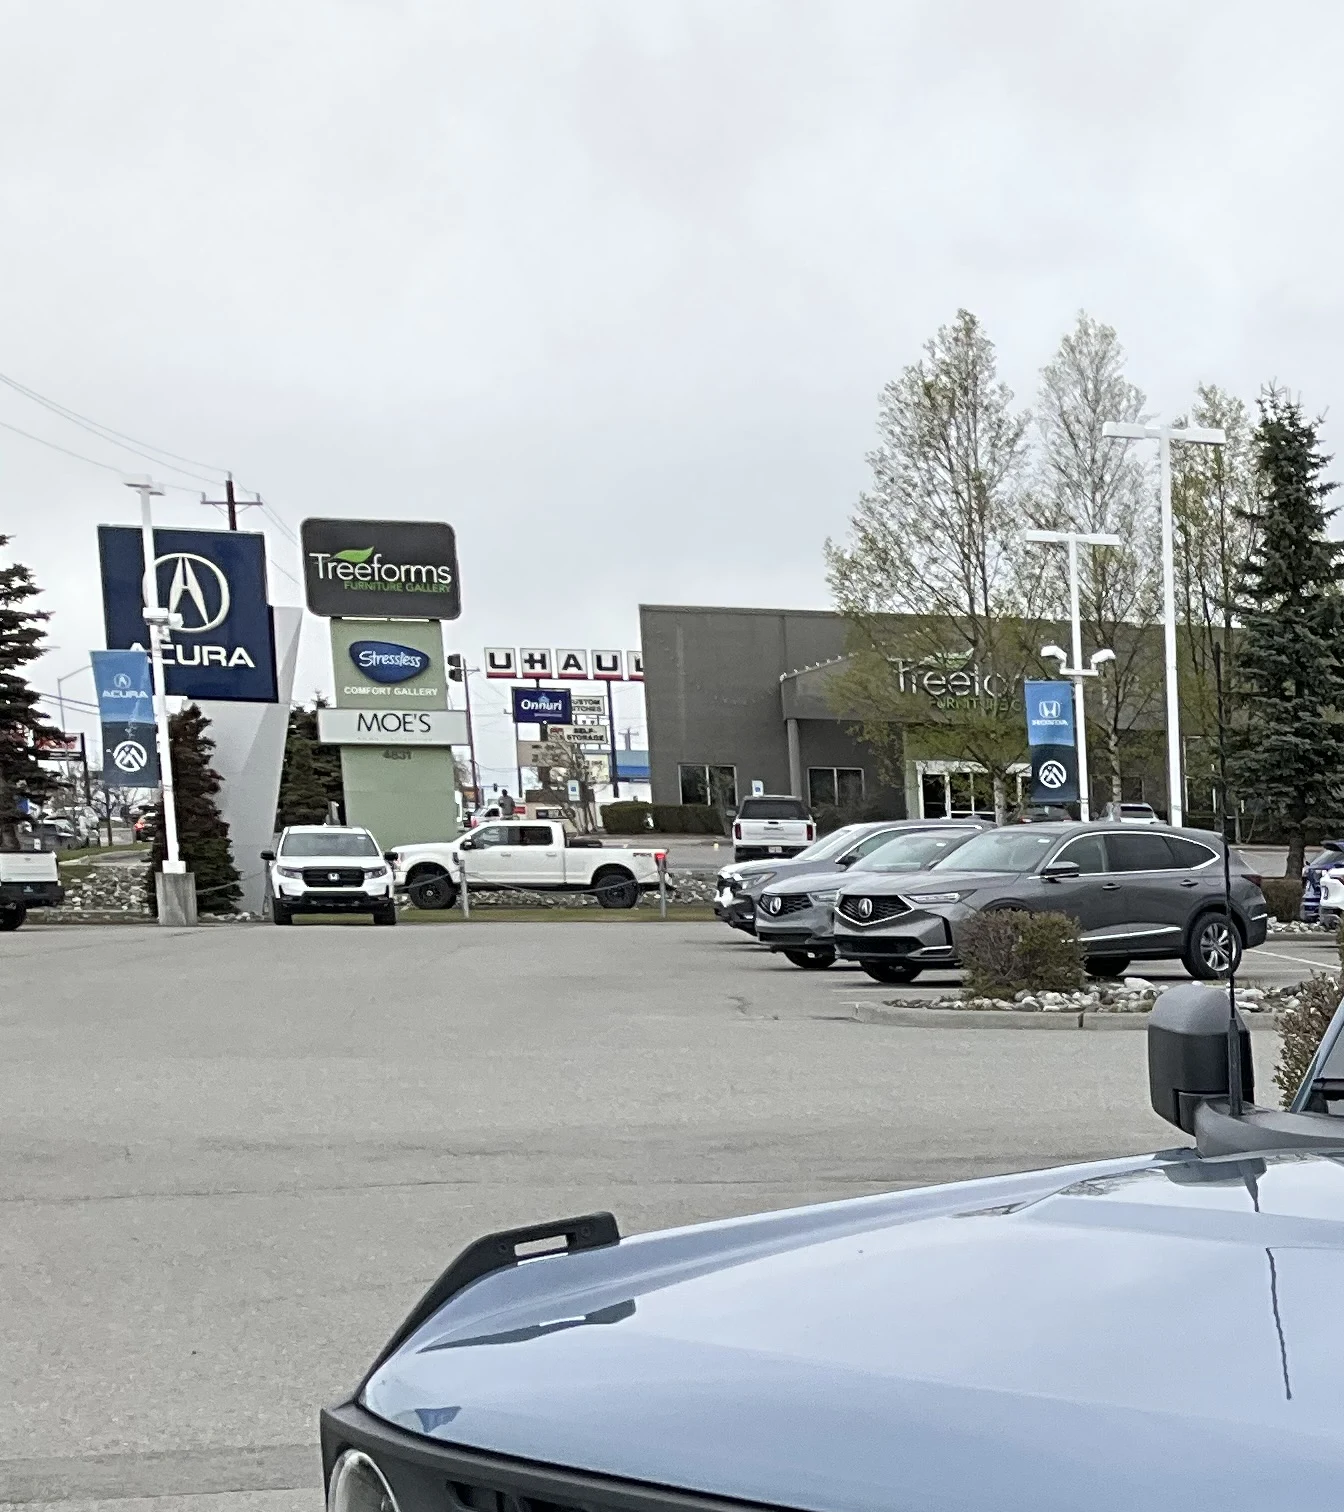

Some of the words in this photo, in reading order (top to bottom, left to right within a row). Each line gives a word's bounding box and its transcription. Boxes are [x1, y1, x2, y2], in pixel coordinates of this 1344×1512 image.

[308, 552, 452, 584] Treeforms
[344, 582, 404, 592] FURNITURE
[406, 582, 452, 593] GALLERY
[358, 650, 422, 668] Stressless
[102, 689, 149, 699] ACURA
[344, 686, 391, 696] COMFORT
[394, 687, 438, 697] GALLERY
[521, 699, 563, 711] Onnuri
[357, 712, 432, 733] MOE'S
